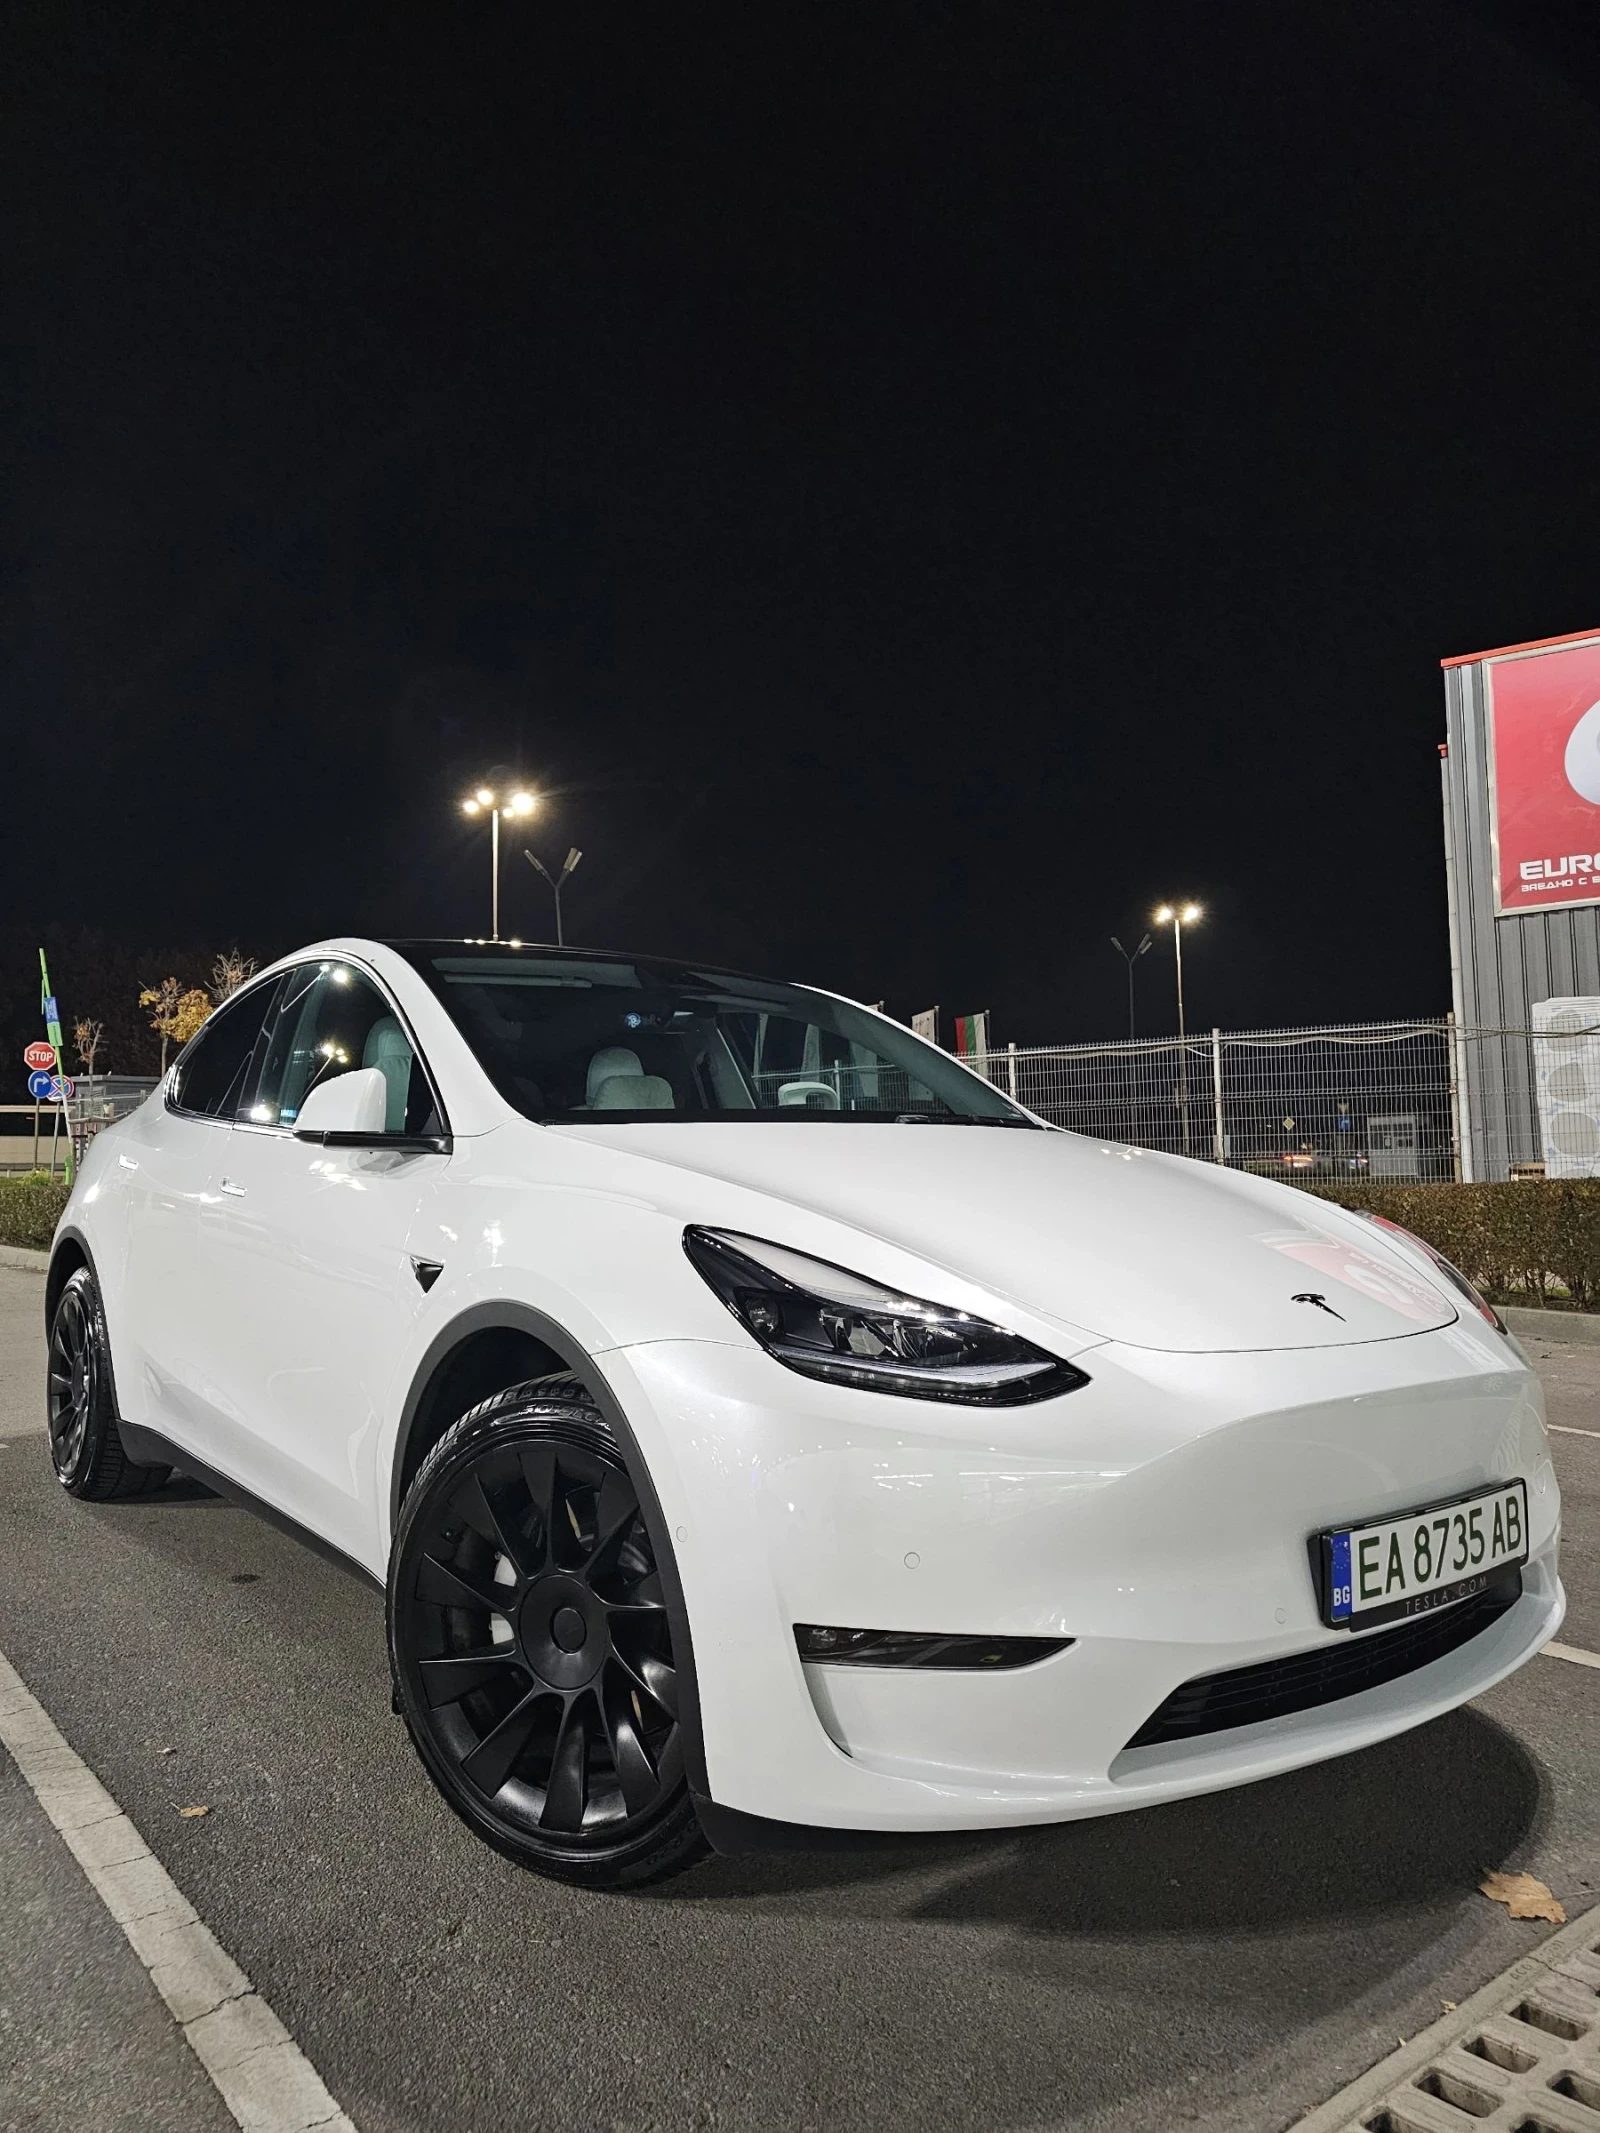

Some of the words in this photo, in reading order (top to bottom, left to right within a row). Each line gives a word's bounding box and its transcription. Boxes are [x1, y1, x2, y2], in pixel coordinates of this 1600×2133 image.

[1520, 852, 1600, 880] EUR
[29, 1050, 53, 1062] STOP
[1358, 1532, 1406, 1602] EA
[1413, 1507, 1485, 1583] 8735
[1491, 1495, 1521, 1559] AB
[1333, 1587, 1351, 1607] BG
[1405, 1576, 1488, 1615] TESLA.COM
